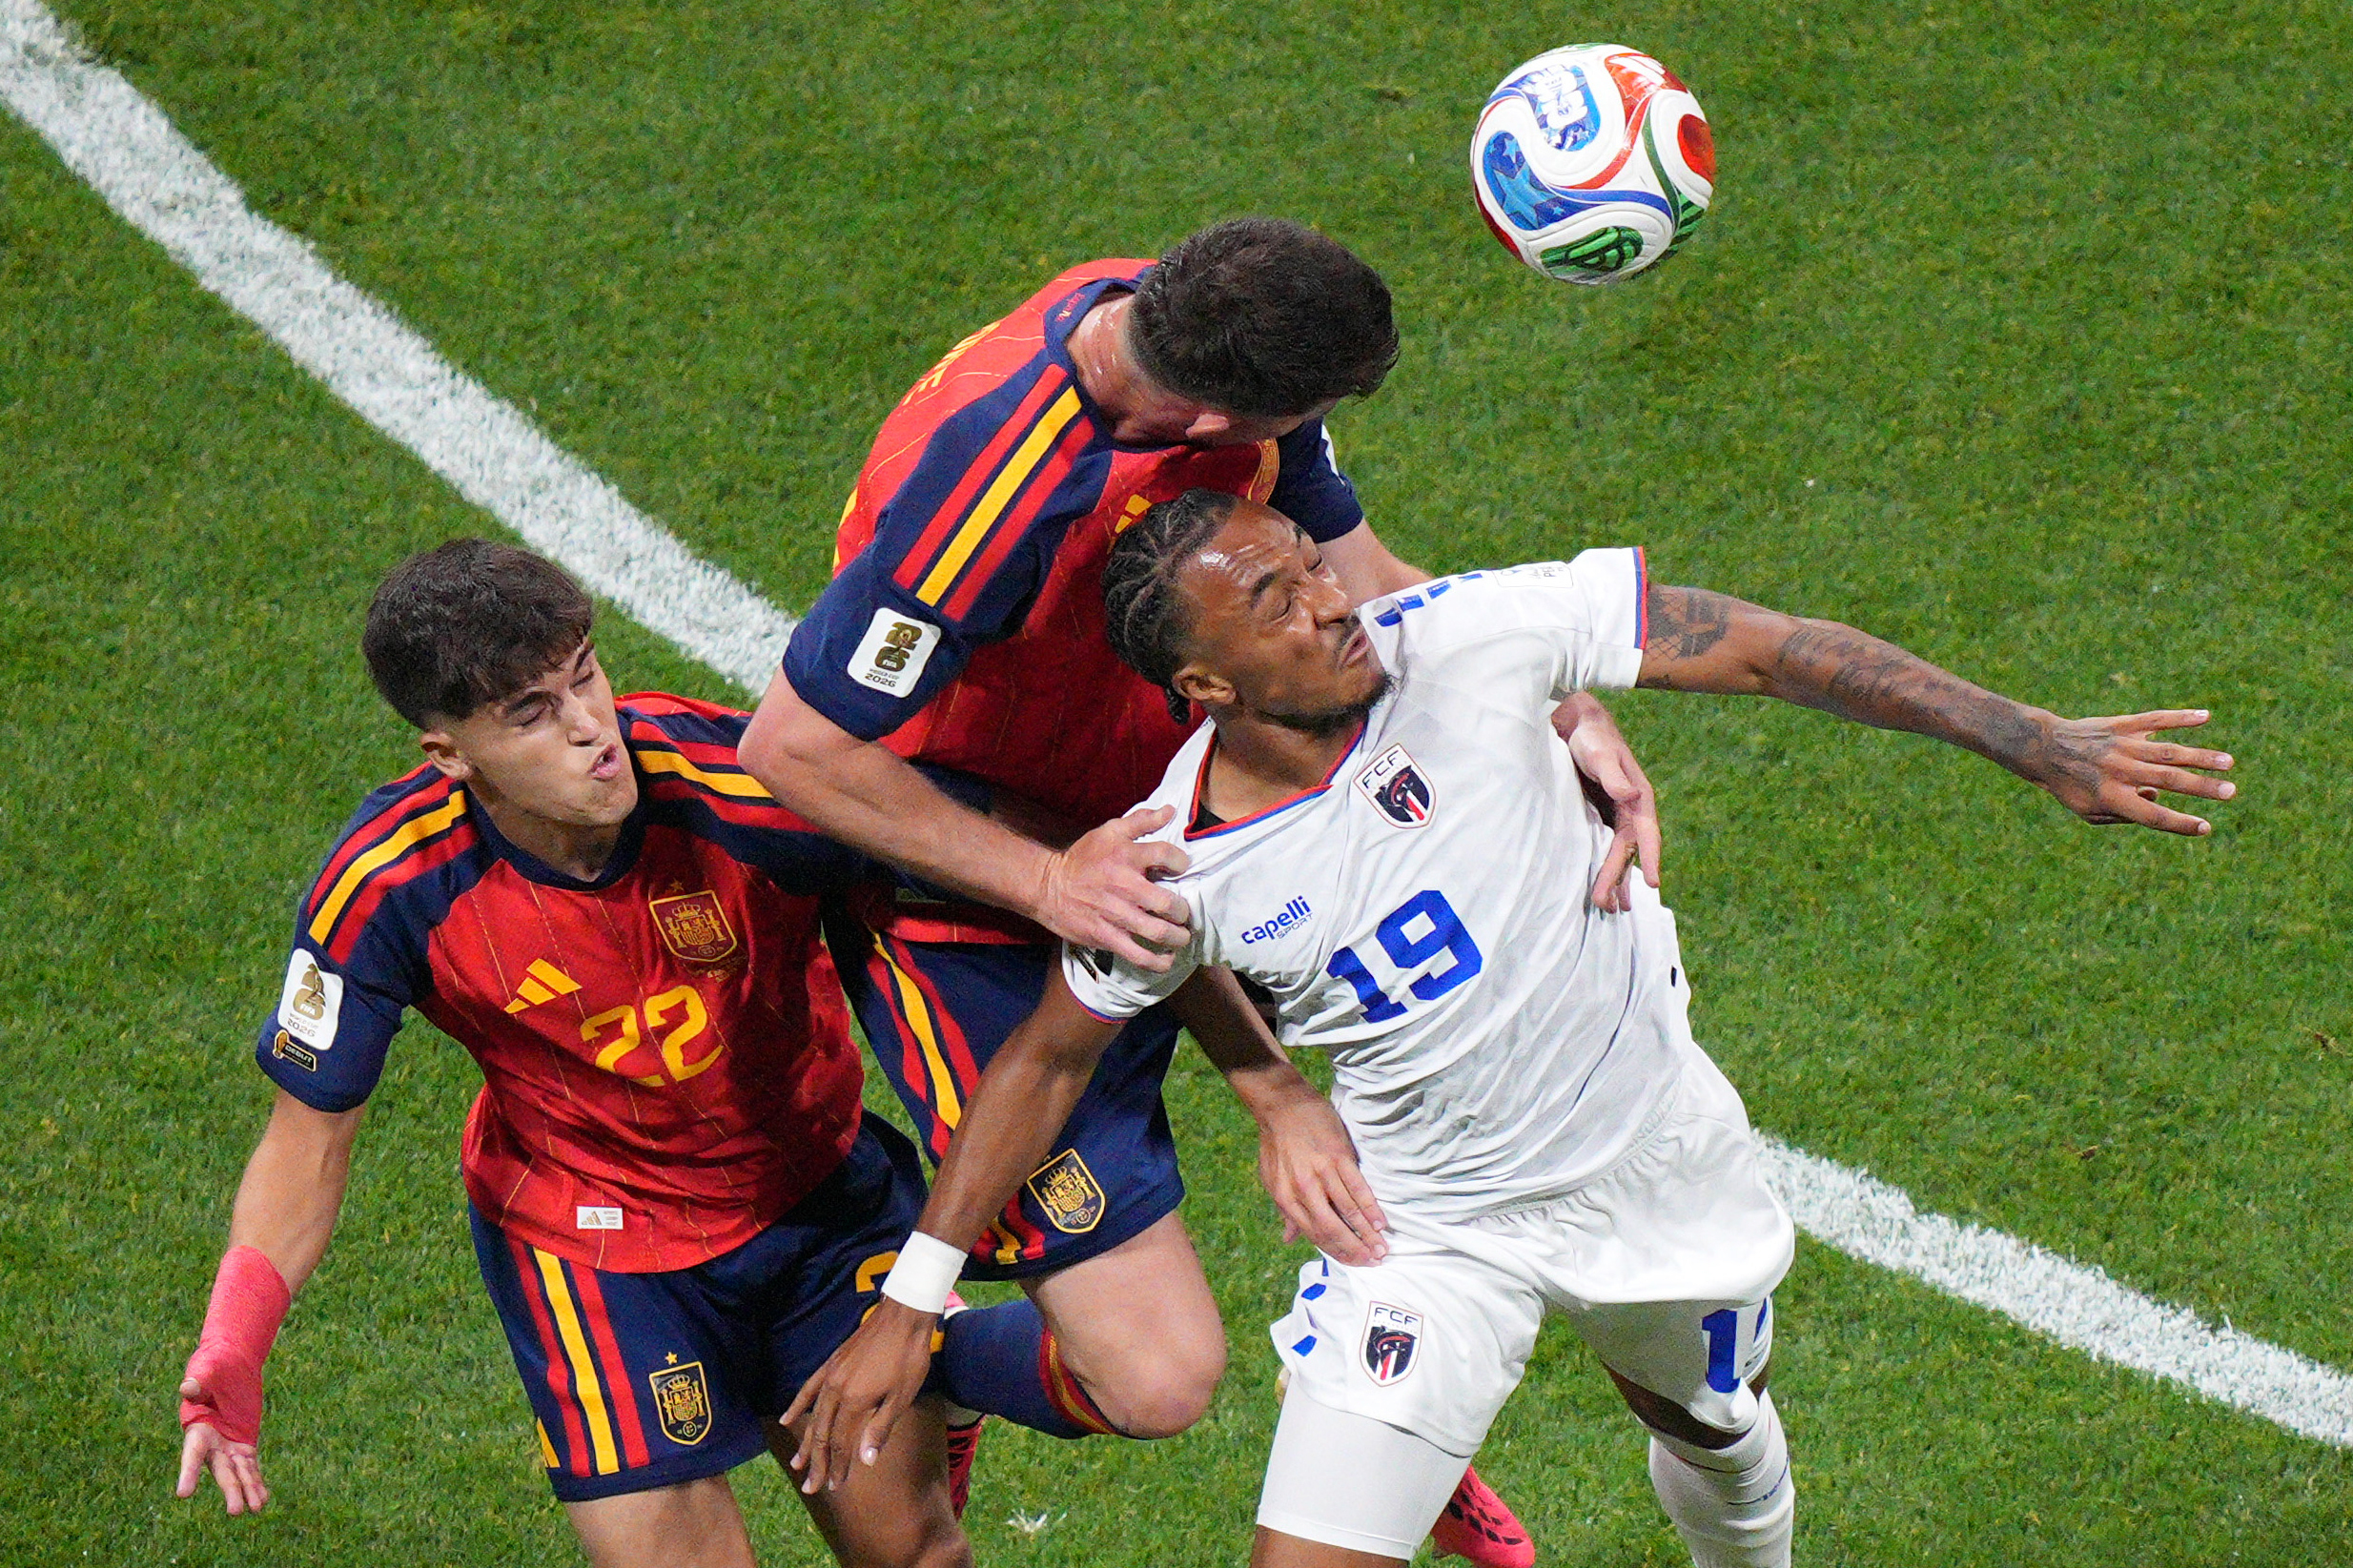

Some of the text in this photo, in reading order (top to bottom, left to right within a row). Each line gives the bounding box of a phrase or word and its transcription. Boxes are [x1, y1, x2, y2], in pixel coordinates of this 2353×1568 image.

[864, 673, 897, 688] 2026
[1361, 749, 1400, 789] FCF
[1240, 895, 1311, 945] capelli
[1277, 912, 1314, 940] SPORT
[1326, 889, 1483, 1024] 19
[299, 1003, 317, 1017] FIFA
[287, 1019, 317, 1038] 2026
[580, 985, 725, 1088] 22
[284, 1045, 314, 1064] DEBUT
[1374, 1307, 1420, 1326] FCF
